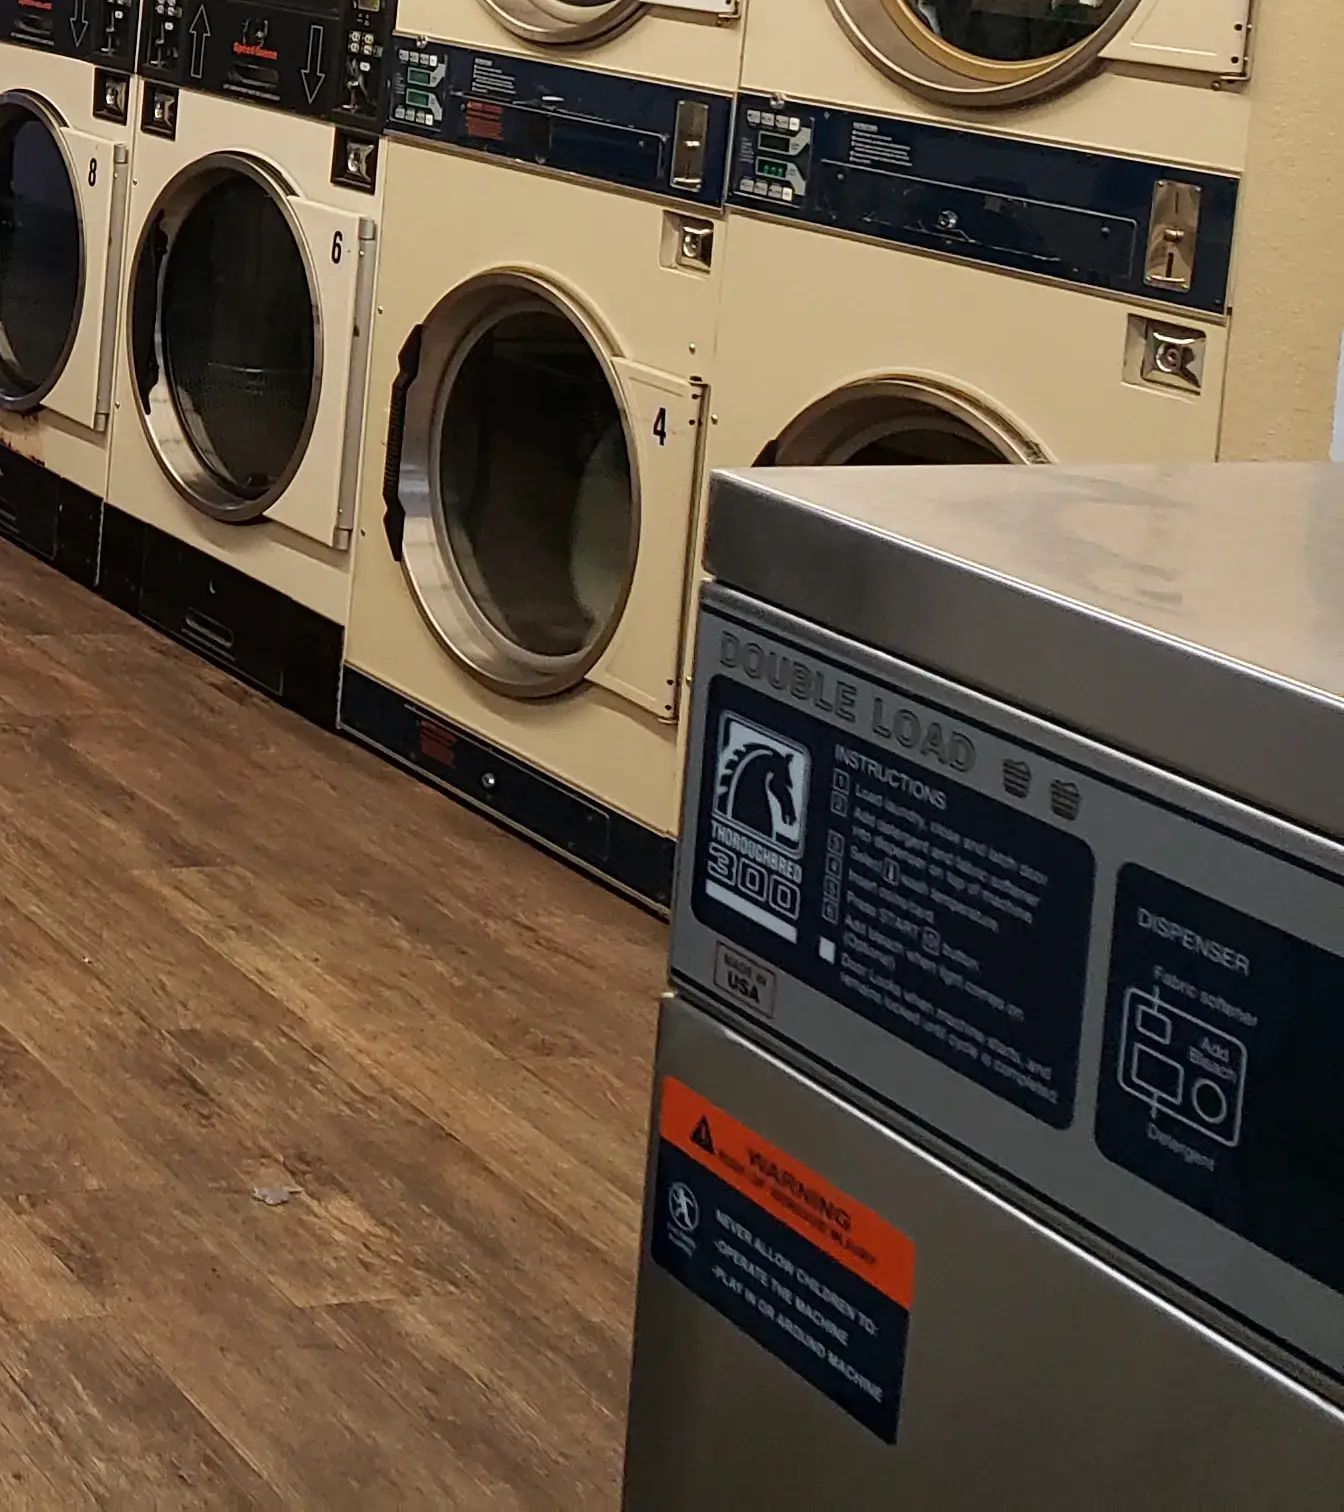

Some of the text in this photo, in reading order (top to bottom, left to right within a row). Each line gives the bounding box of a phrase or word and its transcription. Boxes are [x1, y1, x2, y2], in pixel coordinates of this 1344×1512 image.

[88, 157, 98, 187] 8
[331, 231, 343, 264] 6
[652, 407, 667, 447] 4
[717, 630, 977, 773] DOUBLE LOAD
[834, 744, 948, 810] INSTRUCTIONS
[707, 842, 801, 920] 300
[711, 819, 802, 884] THOROUGHBRED
[1138, 907, 1250, 976] DISPENSER
[728, 971, 760, 1003] USA
[1153, 965, 1258, 1026] Fabric softener
[748, 1148, 851, 1232] WARNING
[716, 1208, 753, 1241] NEVER
[754, 1238, 794, 1276] ALLOW
[796, 1271, 856, 1321] CHILDREN
[771, 1281, 793, 1305] THE
[795, 1295, 849, 1346] MACHINE
[744, 1290, 757, 1306] IN
[757, 1299, 775, 1320] OR
[776, 1313, 826, 1358] AROUND
[828, 1351, 883, 1403] MACHINE
